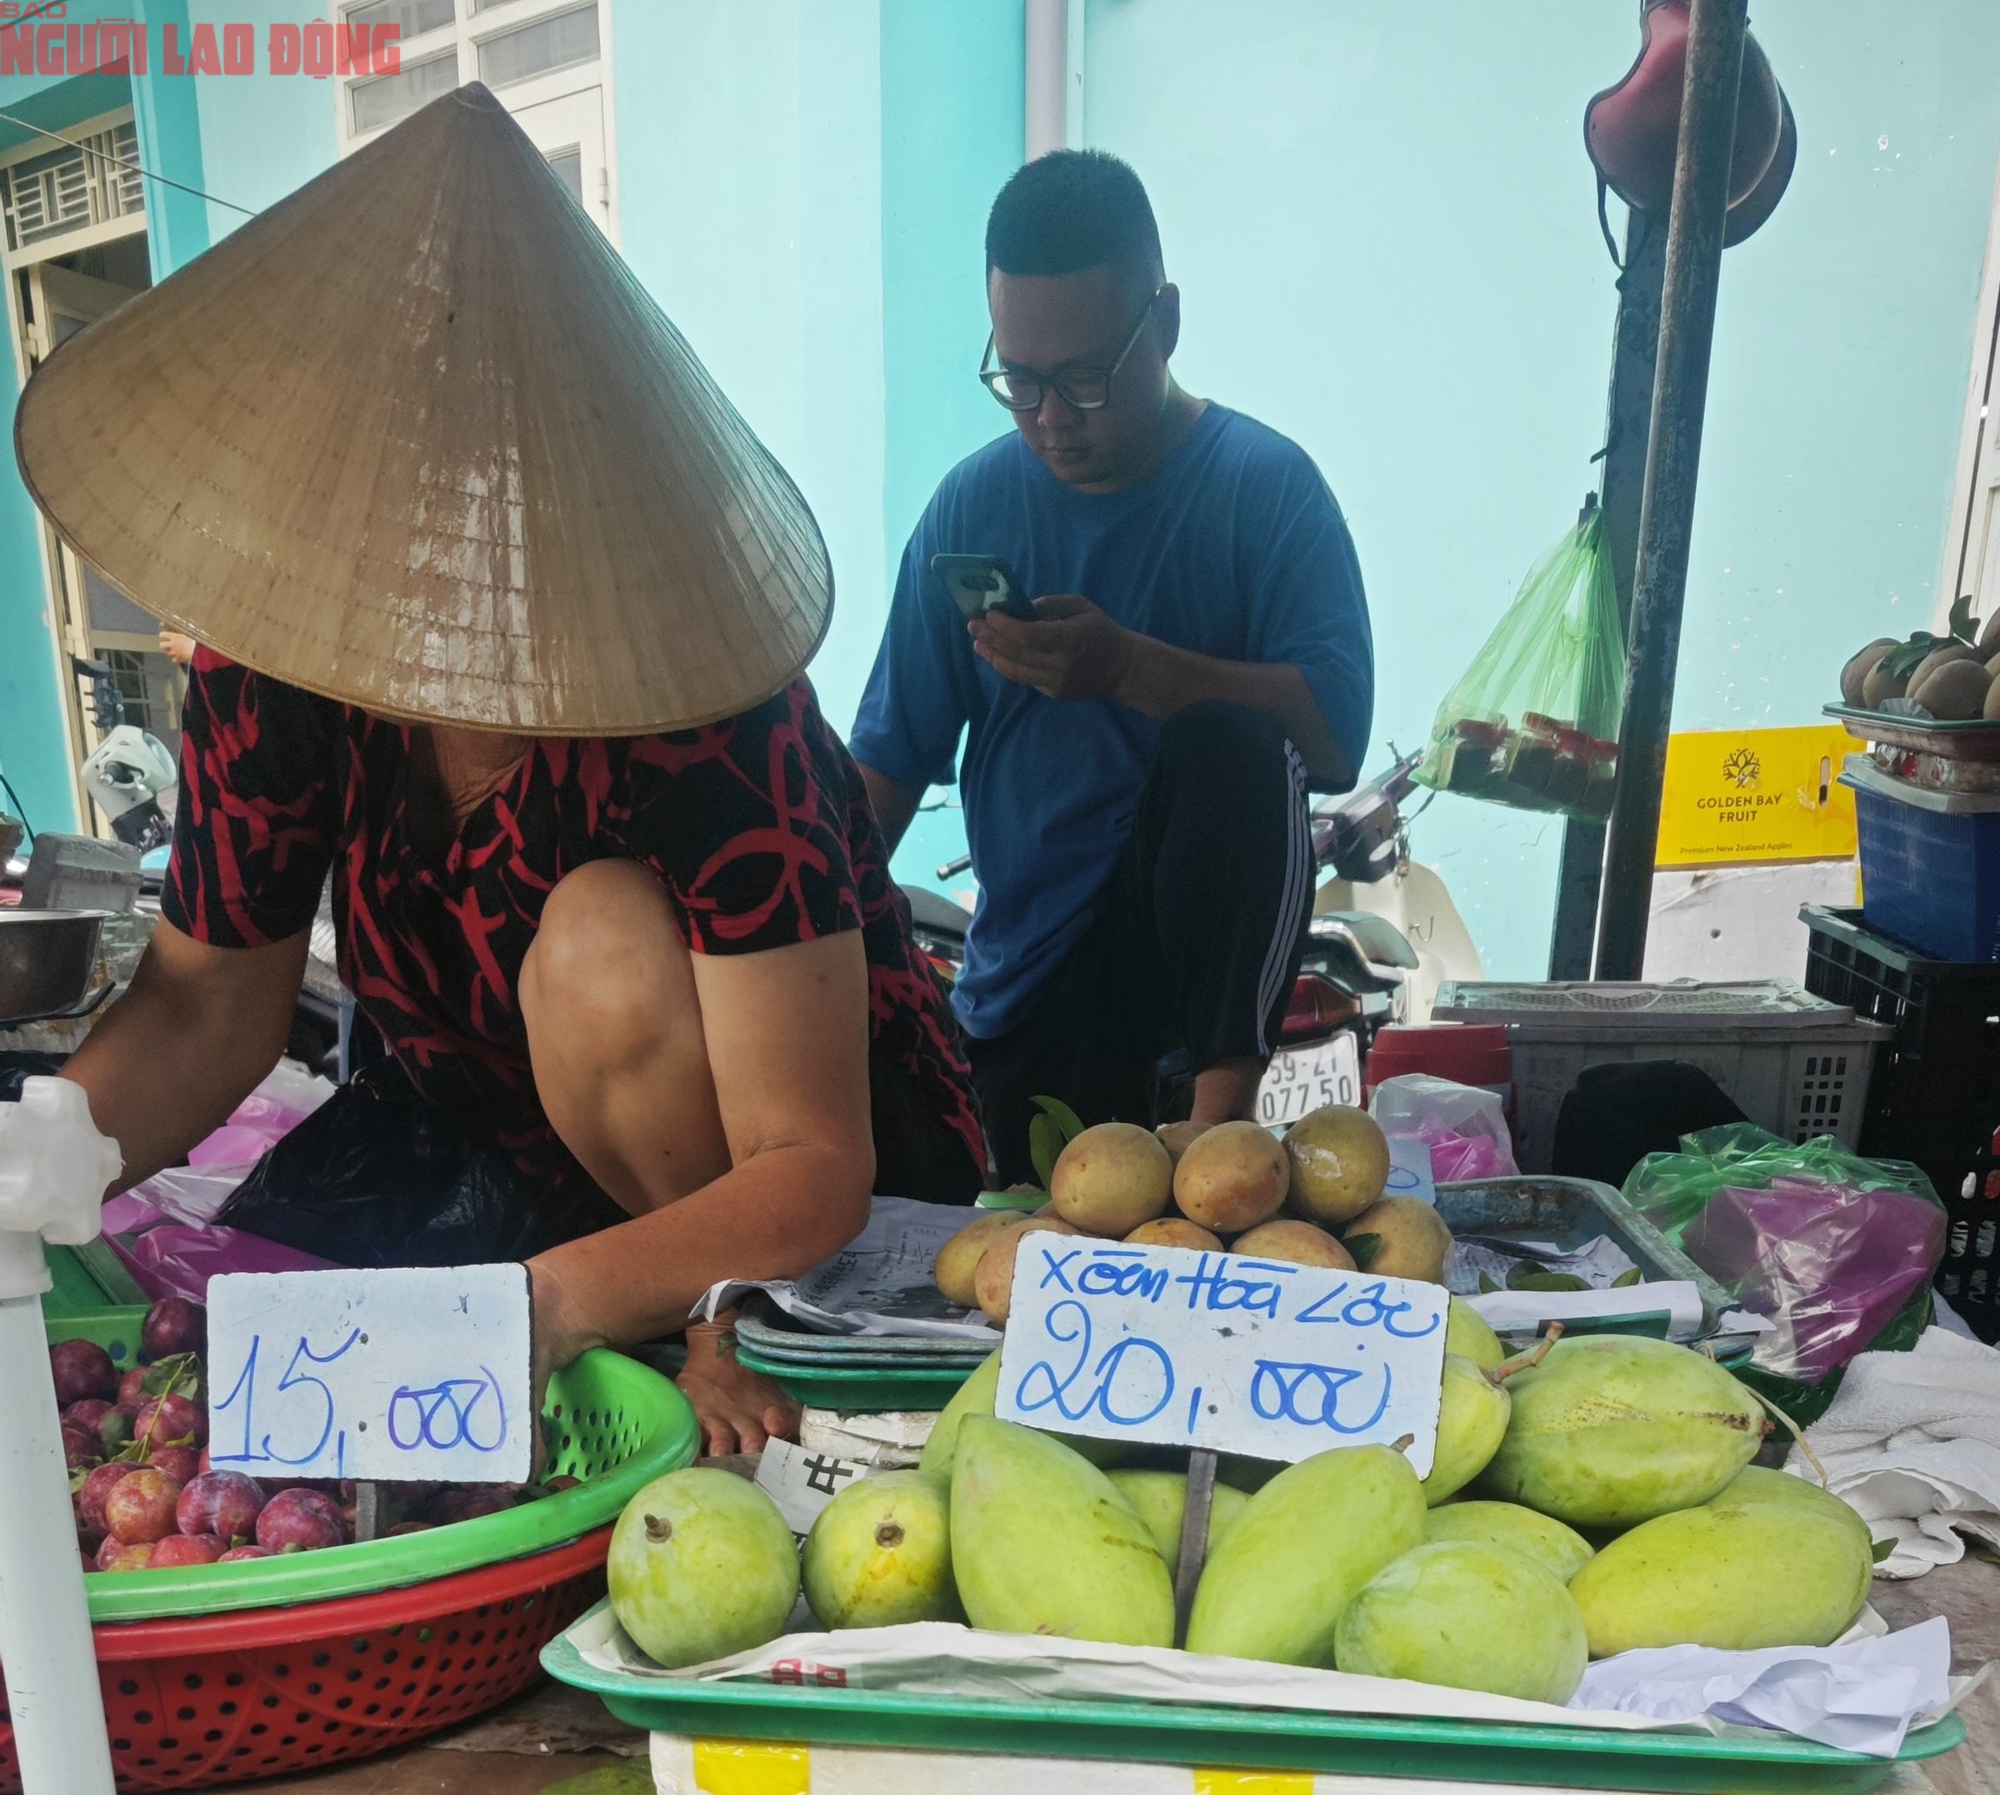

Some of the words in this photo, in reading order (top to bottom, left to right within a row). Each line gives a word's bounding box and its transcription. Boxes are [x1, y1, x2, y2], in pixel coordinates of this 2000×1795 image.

[1697, 795, 1752, 809] GOLDEN
[1756, 793, 1782, 806] BAY
[1718, 810, 1758, 823] FRUIT
[1680, 846, 1714, 855] Premium
[1716, 844, 1734, 853] New
[1735, 842, 1765, 853] Zealand
[1766, 841, 1793, 852] Apples
